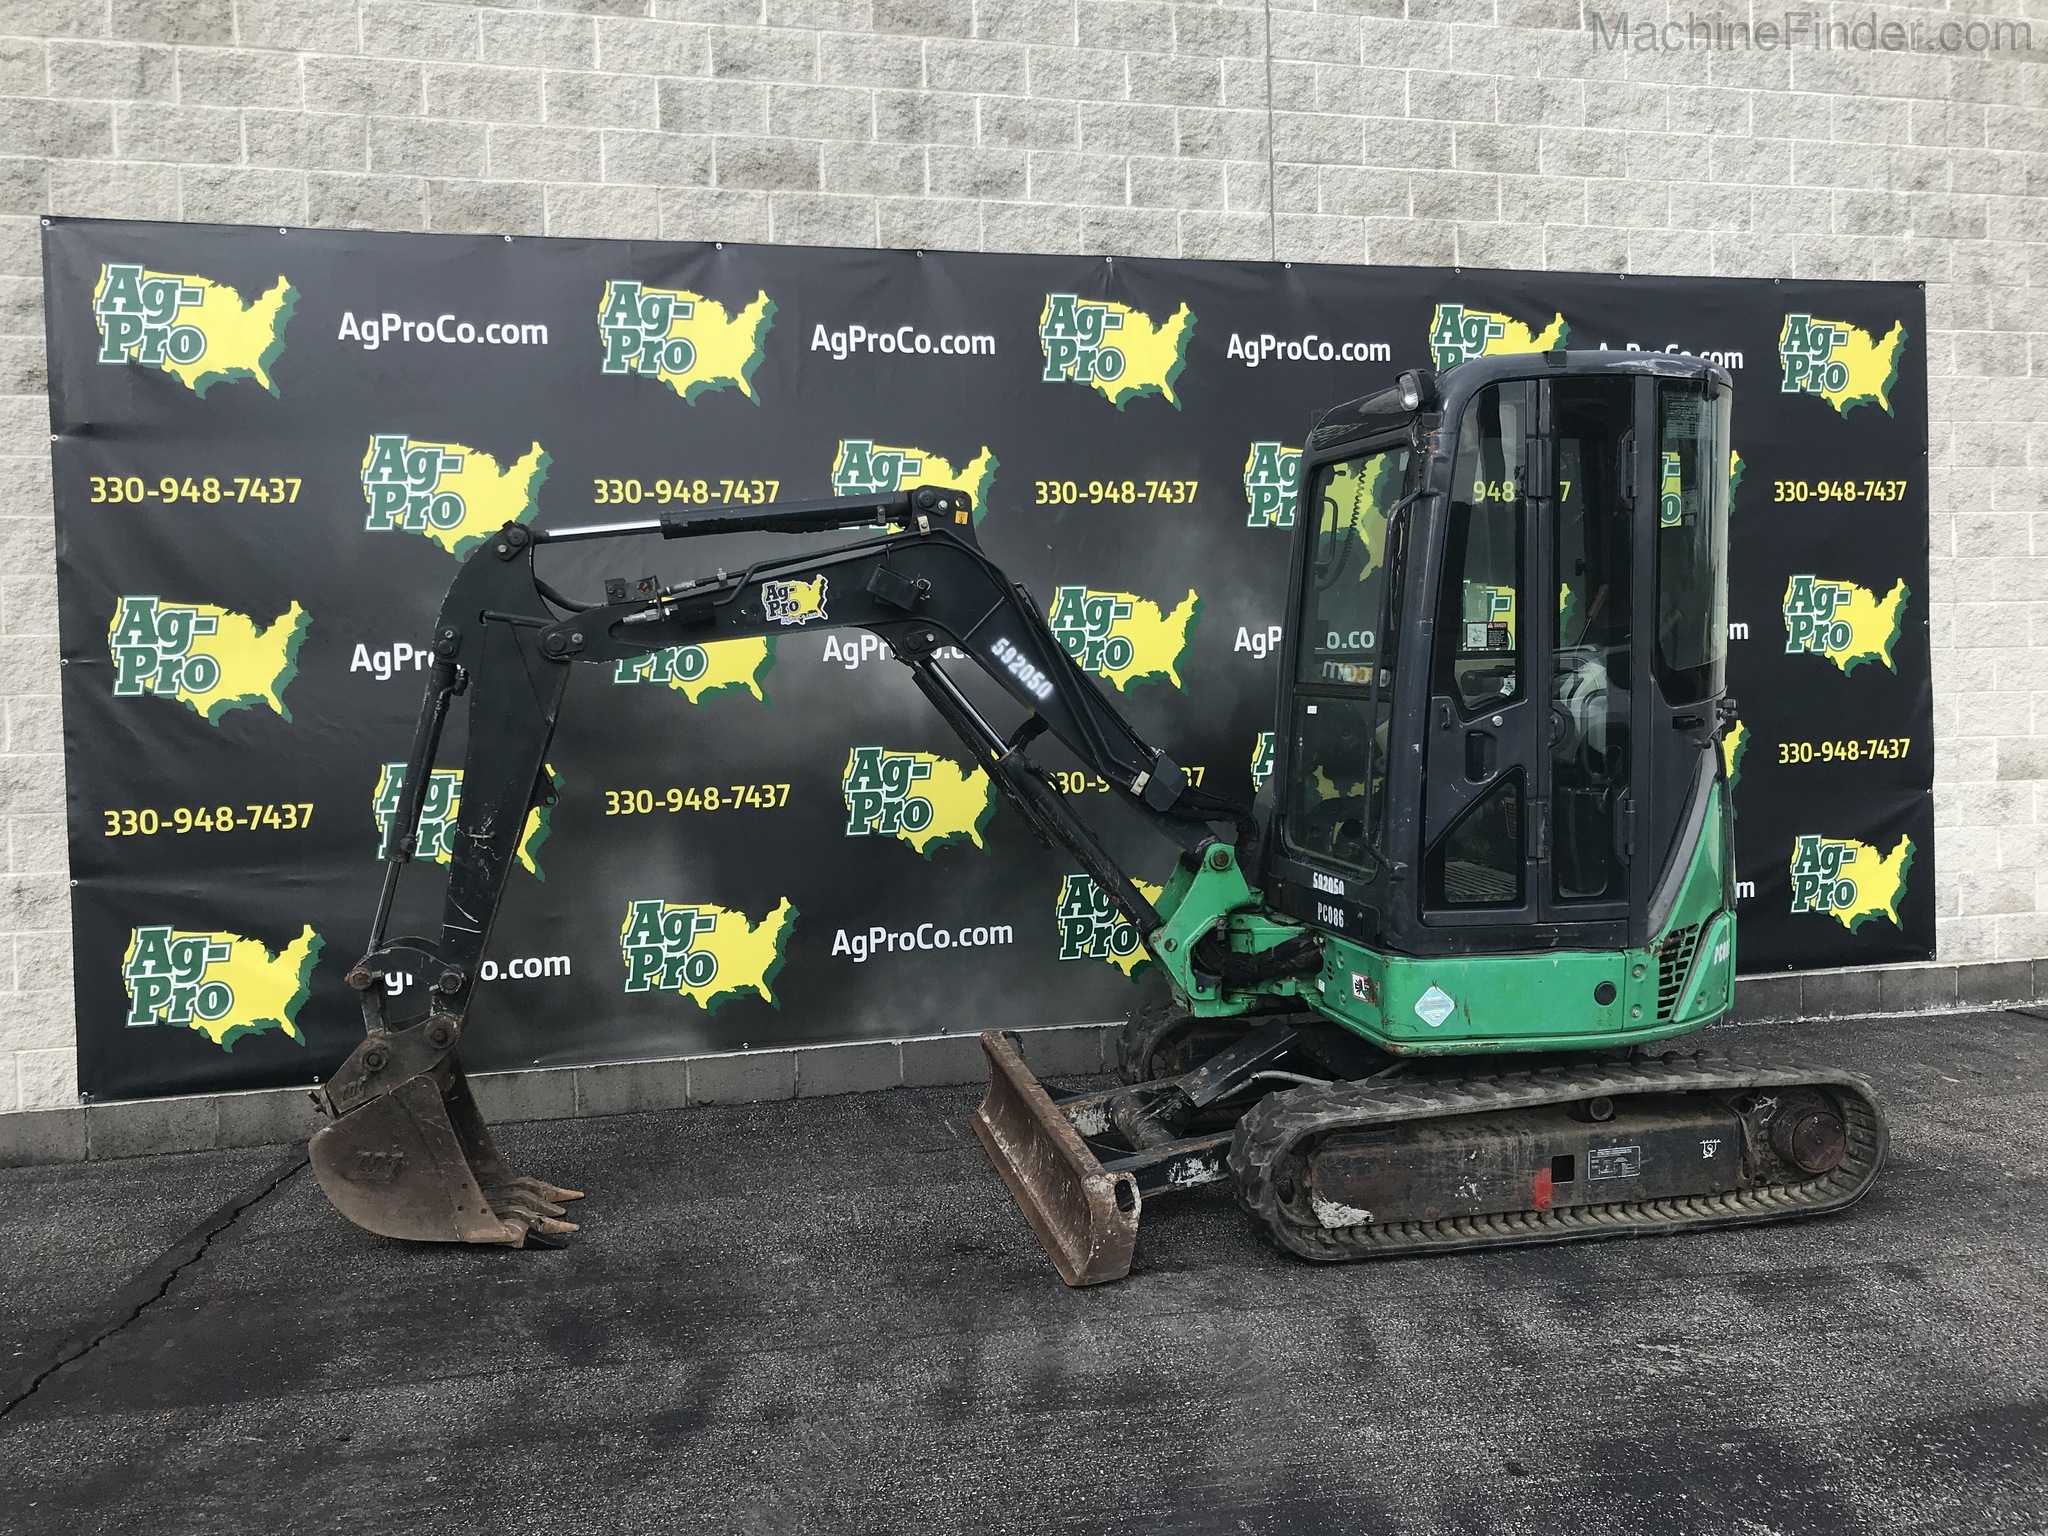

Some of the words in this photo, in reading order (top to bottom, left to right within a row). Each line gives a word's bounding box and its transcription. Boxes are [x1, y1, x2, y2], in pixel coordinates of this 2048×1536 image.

[96, 264, 203, 328] Ag-
[600, 281, 693, 341] Ag-
[99, 313, 205, 363] Pro
[337, 311, 549, 351] AgProCo.com
[810, 323, 996, 361] AgProCo.com
[1042, 294, 1122, 349] Ag-
[1431, 305, 1504, 357] Ag-
[1781, 315, 1847, 362] Ag-
[602, 327, 695, 373] Pro
[1043, 337, 1124, 381] Pro
[1226, 333, 1391, 368] AgProCo.com
[1781, 352, 1848, 392] Pro
[365, 436, 463, 494] Ag-
[835, 441, 920, 492] Ag-
[90, 476, 302, 504] 330-948-7437
[367, 481, 465, 530] Pro
[595, 478, 780, 505] 330-948-7437
[1035, 480, 1199, 505] 330-948-7437
[1775, 480, 1907, 503] 330-948-7437
[766, 585, 796, 602] Ag-
[768, 600, 800, 617] Pro
[1051, 587, 1131, 640] Ag-
[1785, 575, 1850, 622] Ag-
[111, 597, 216, 660] Ag-
[1055, 629, 1133, 671] Pro
[1786, 613, 1852, 653] Pro
[114, 645, 218, 695] Pro
[822, 634, 894, 670] AgPr
[991, 637, 1053, 699] 592050
[845, 747, 931, 799] Ag-
[1778, 738, 1911, 764] 330-948-7437
[104, 803, 314, 837] 330-948-7437
[605, 783, 791, 816] 330-948-7437
[846, 790, 932, 835] Pro
[1793, 835, 1856, 881] Ag-
[1317, 901, 1344, 928] PC086
[1791, 873, 1857, 913] Pro
[623, 900, 715, 956] Ag-
[831, 923, 1013, 963] AgProCo.com
[1059, 917, 1139, 960] Pro
[125, 926, 230, 990] Ag-
[624, 946, 717, 992] Pro
[128, 974, 231, 1026] Pro
